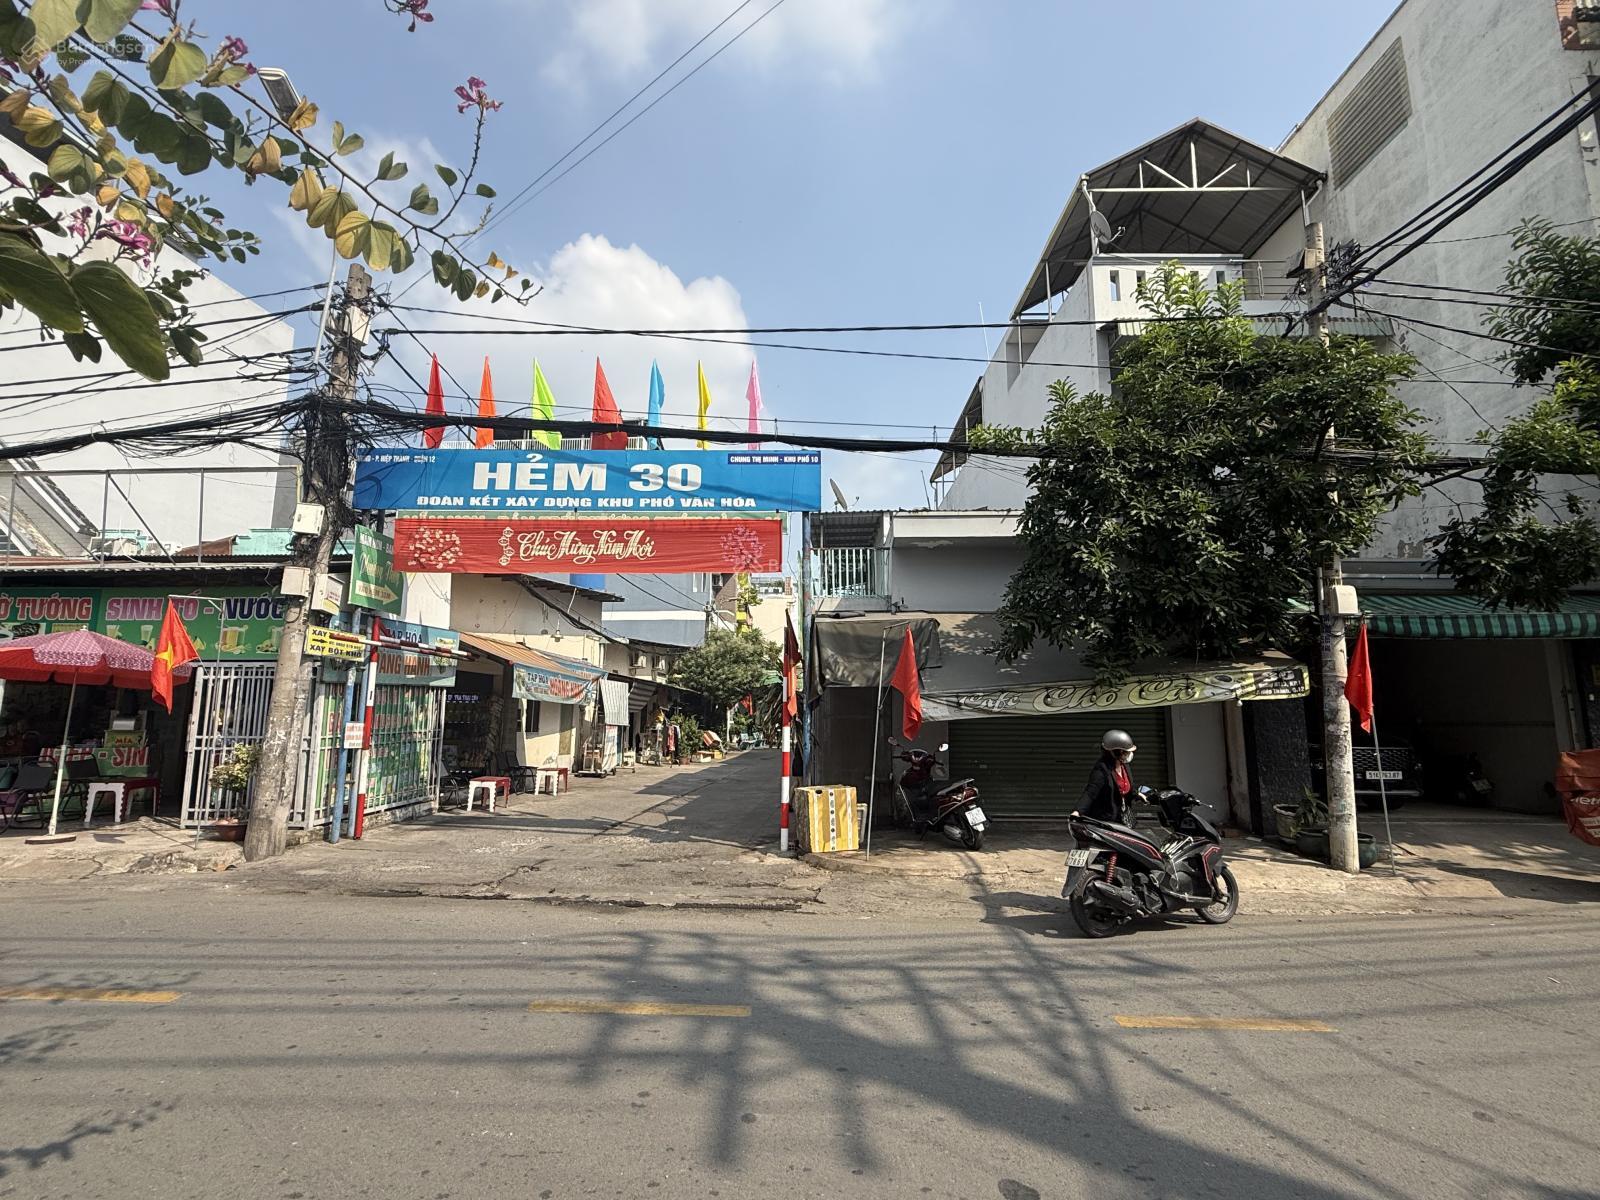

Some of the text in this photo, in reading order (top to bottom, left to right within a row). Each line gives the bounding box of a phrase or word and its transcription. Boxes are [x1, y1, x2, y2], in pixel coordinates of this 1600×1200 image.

[429, 455, 436, 463] 12
[730, 455, 751, 463] CHUNG
[752, 455, 761, 464] THỊ
[762, 455, 779, 463] MINH
[784, 455, 796, 463] KHU
[797, 453, 810, 463] PHỐ
[811, 455, 819, 463] 10
[473, 453, 702, 492] HẺM 30
[416, 495, 464, 506] ĐOÀN
[469, 493, 502, 507] KẾT
[505, 495, 541, 507] XÂY
[543, 496, 592, 509] DỰNG
[597, 497, 635, 508] KHU
[639, 495, 675, 508] PHỐ
[720, 496, 757, 508] HÓA
[517, 529, 656, 565] Chúc Mừng Năm Mới
[15, 592, 93, 620] TƯỚNG
[105, 597, 165, 620] SINH
[311, 628, 328, 637] XAY
[309, 643, 326, 652] XAY
